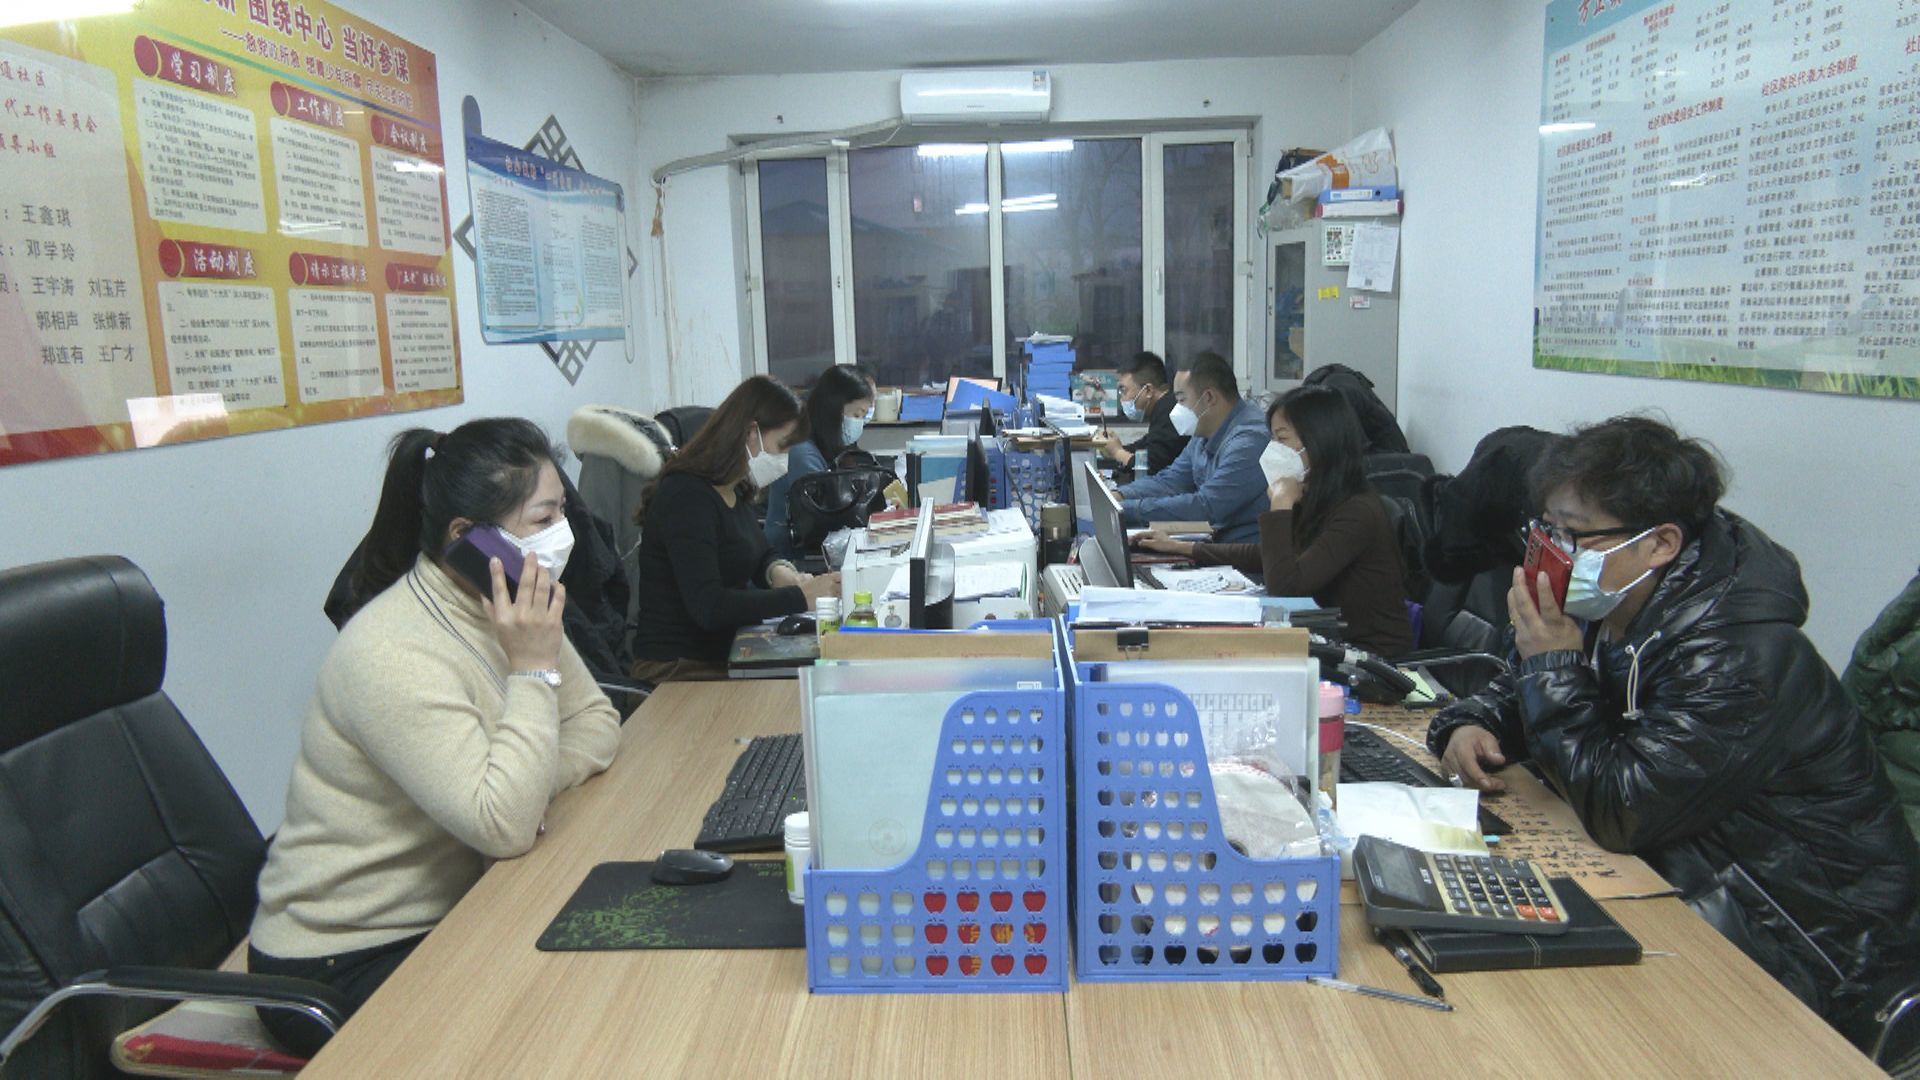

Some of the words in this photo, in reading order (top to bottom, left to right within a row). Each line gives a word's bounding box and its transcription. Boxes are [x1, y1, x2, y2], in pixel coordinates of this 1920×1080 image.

[343, 26, 410, 83] 当好参谋
[171, 50, 237, 98] 学习制度
[297, 97, 345, 128] 工作制度
[193, 248, 257, 277] 活动制度
[88, 278, 127, 298] 刘玉芹
[99, 345, 135, 363] 王广才
